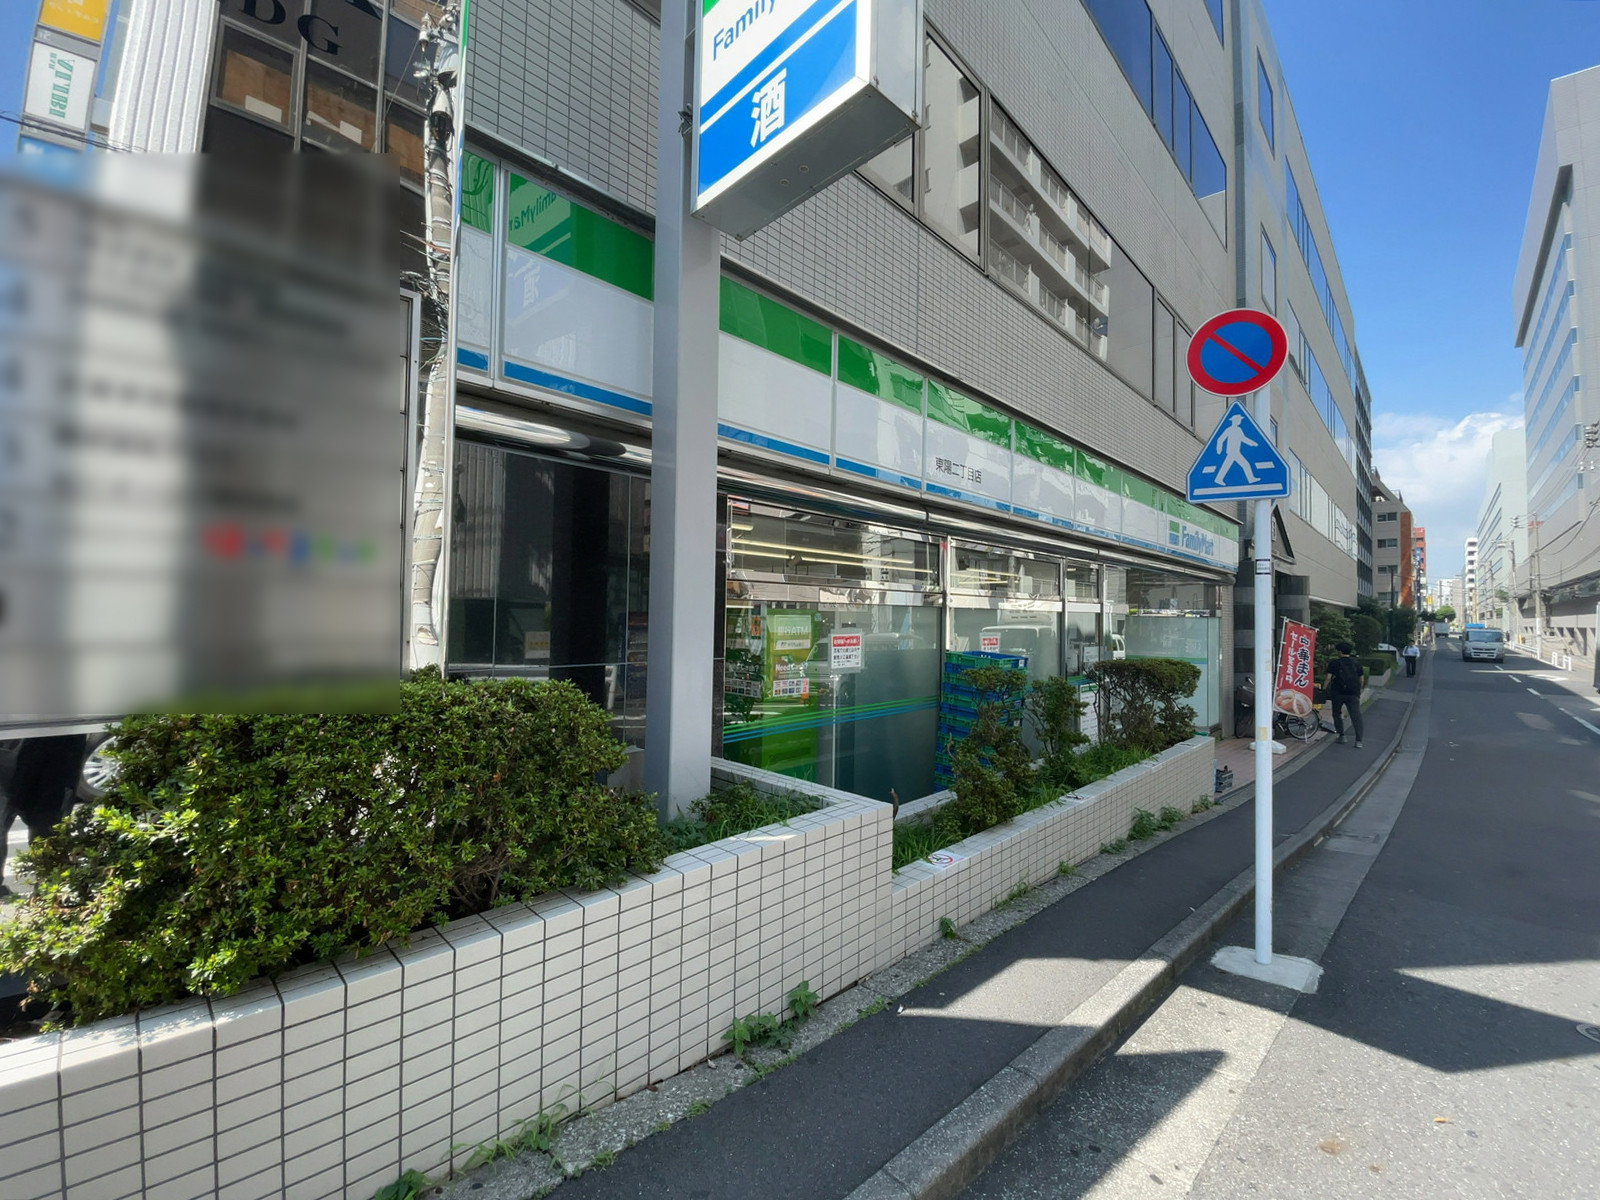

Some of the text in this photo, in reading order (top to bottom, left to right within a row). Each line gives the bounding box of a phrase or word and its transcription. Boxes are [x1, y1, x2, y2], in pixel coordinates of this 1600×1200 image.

[750, 67, 787, 148] 酒
[935, 456, 982, 484] 東陽二丁目店
[1181, 525, 1215, 557] FamilyMart
[1294, 634, 1311, 688] 中華まん
